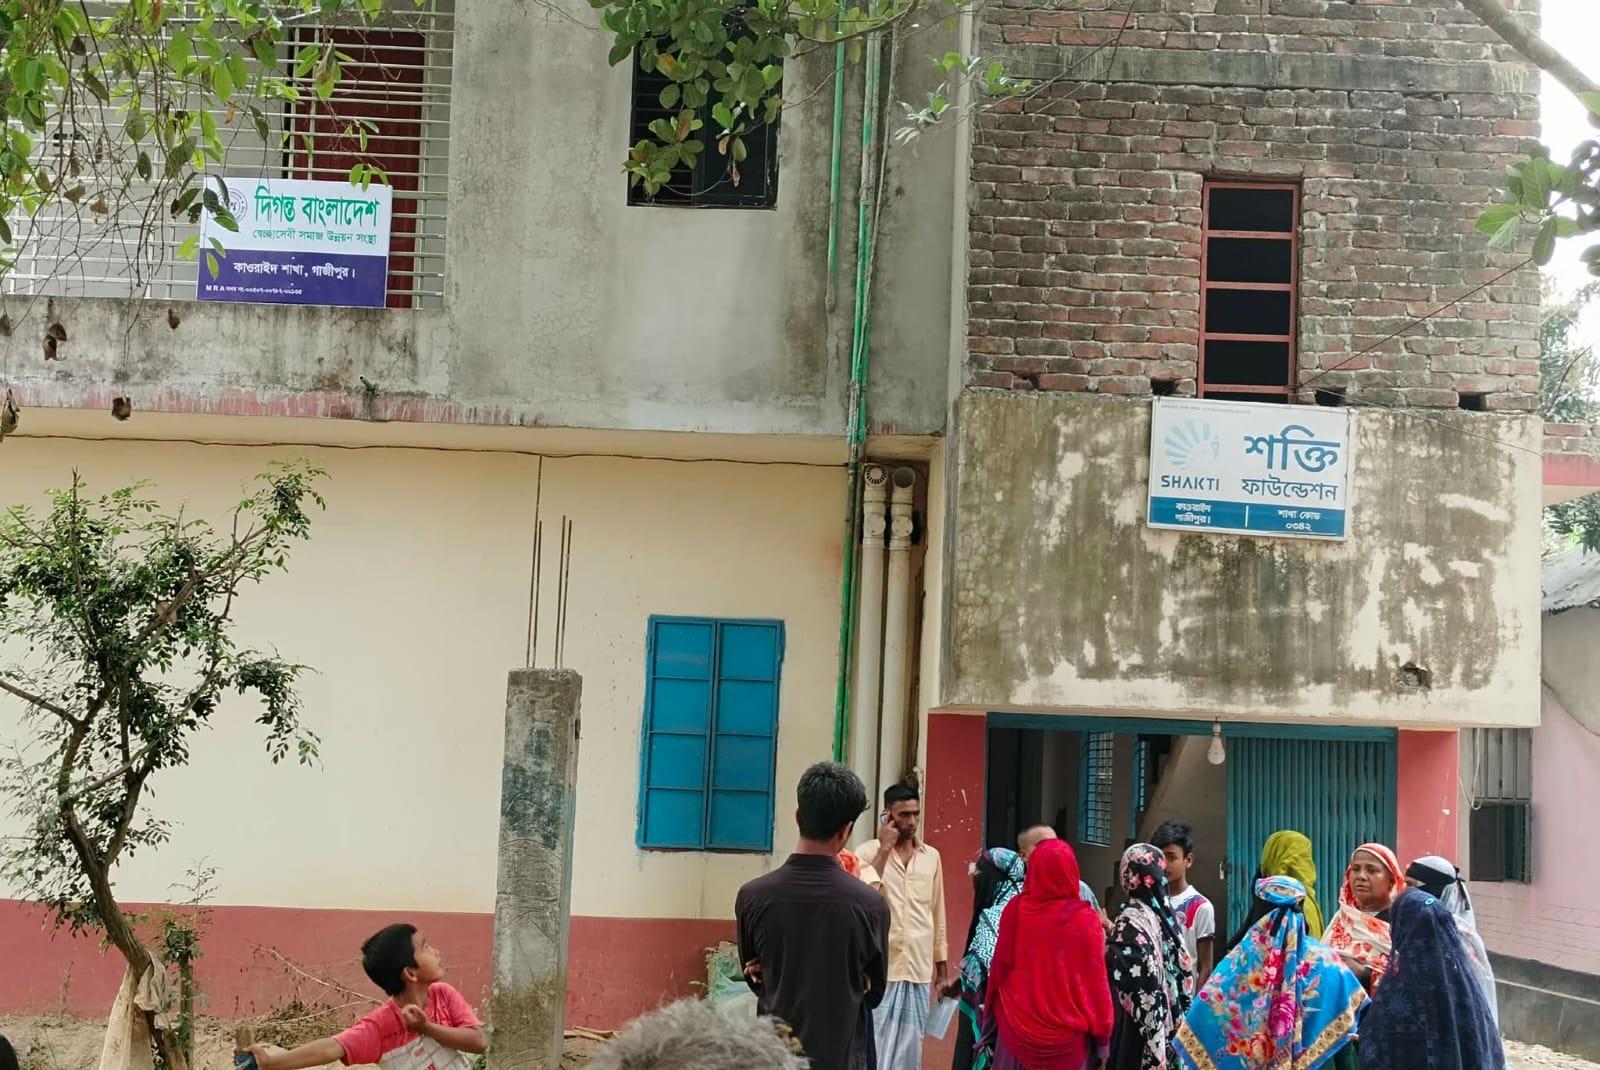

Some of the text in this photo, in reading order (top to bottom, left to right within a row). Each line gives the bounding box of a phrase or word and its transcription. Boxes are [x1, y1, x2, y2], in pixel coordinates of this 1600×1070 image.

[254, 185, 296, 223] দিগন্ত
[301, 195, 380, 227] বাংলাদেশ
[298, 230, 324, 241] সমাজ
[233, 261, 277, 275] কাওরাইদ
[1243, 424, 1341, 473] শক্তি
[1160, 474, 1220, 491] SHAKTI
[1241, 473, 1339, 501] ফাউন্ডেশন
[1278, 508, 1322, 520] শাখা কোড
